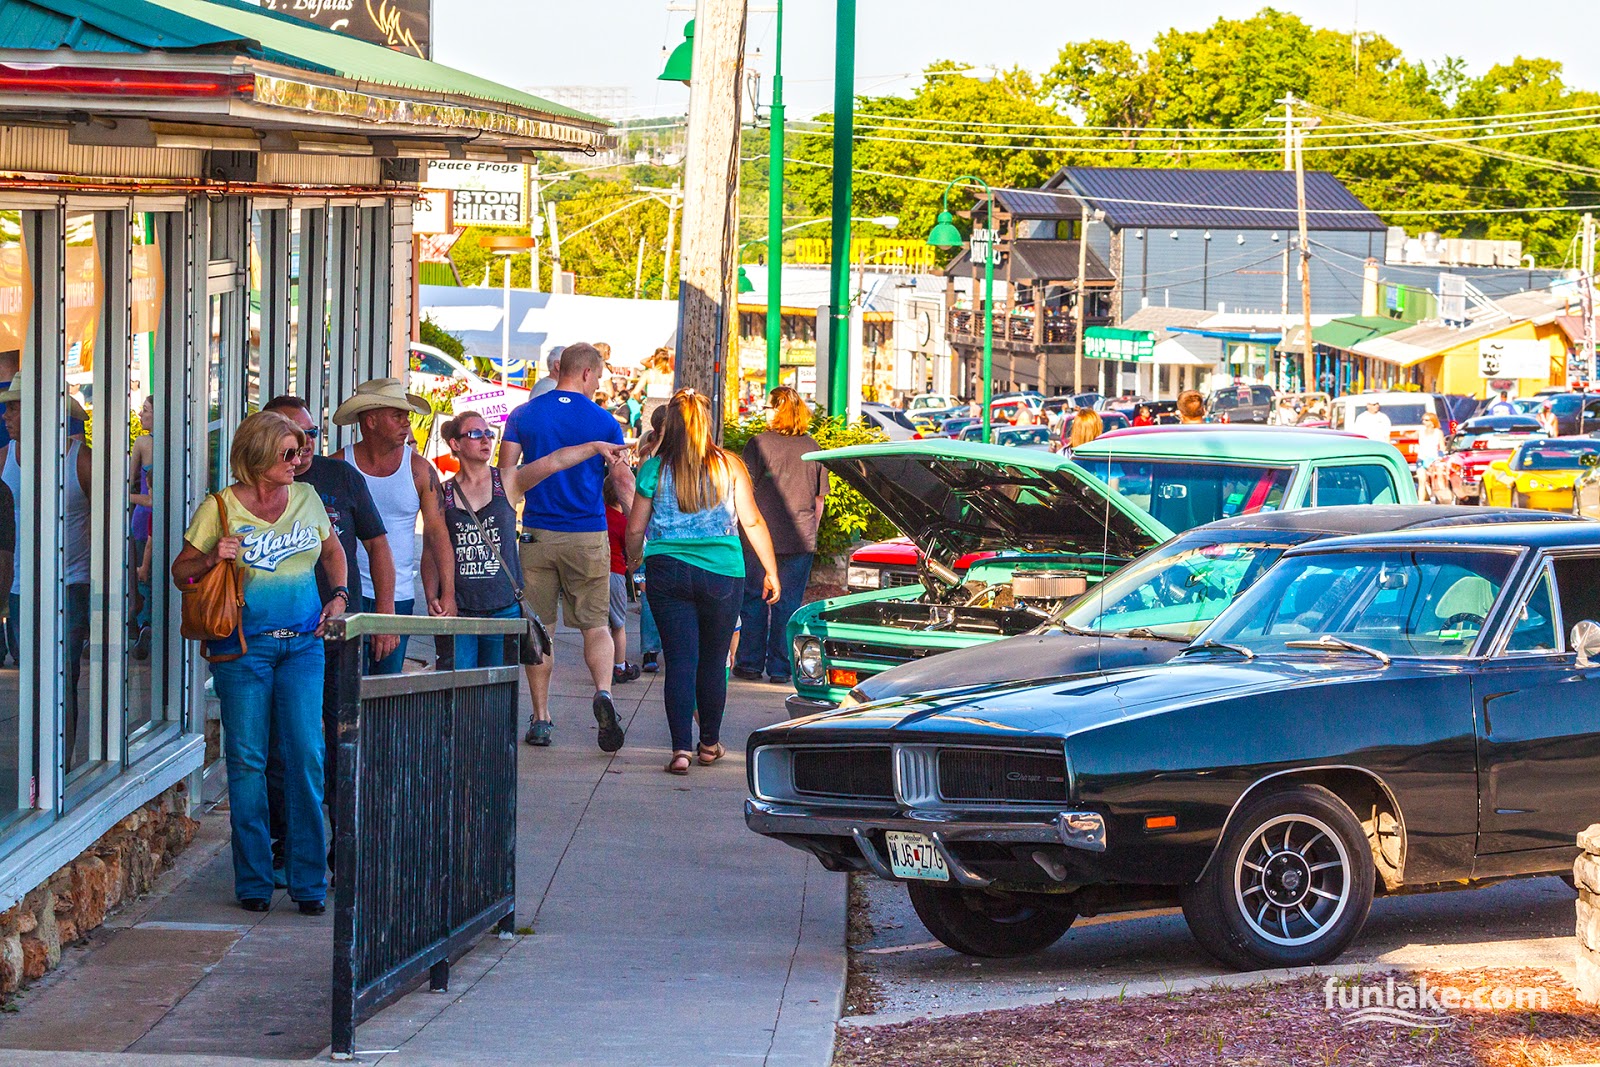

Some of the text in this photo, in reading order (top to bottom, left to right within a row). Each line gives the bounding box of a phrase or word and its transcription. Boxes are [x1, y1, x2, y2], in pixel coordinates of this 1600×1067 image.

[428, 160, 518, 174] Peace Frogs
[241, 520, 318, 563] Harley
[460, 562, 485, 576] GIRL
